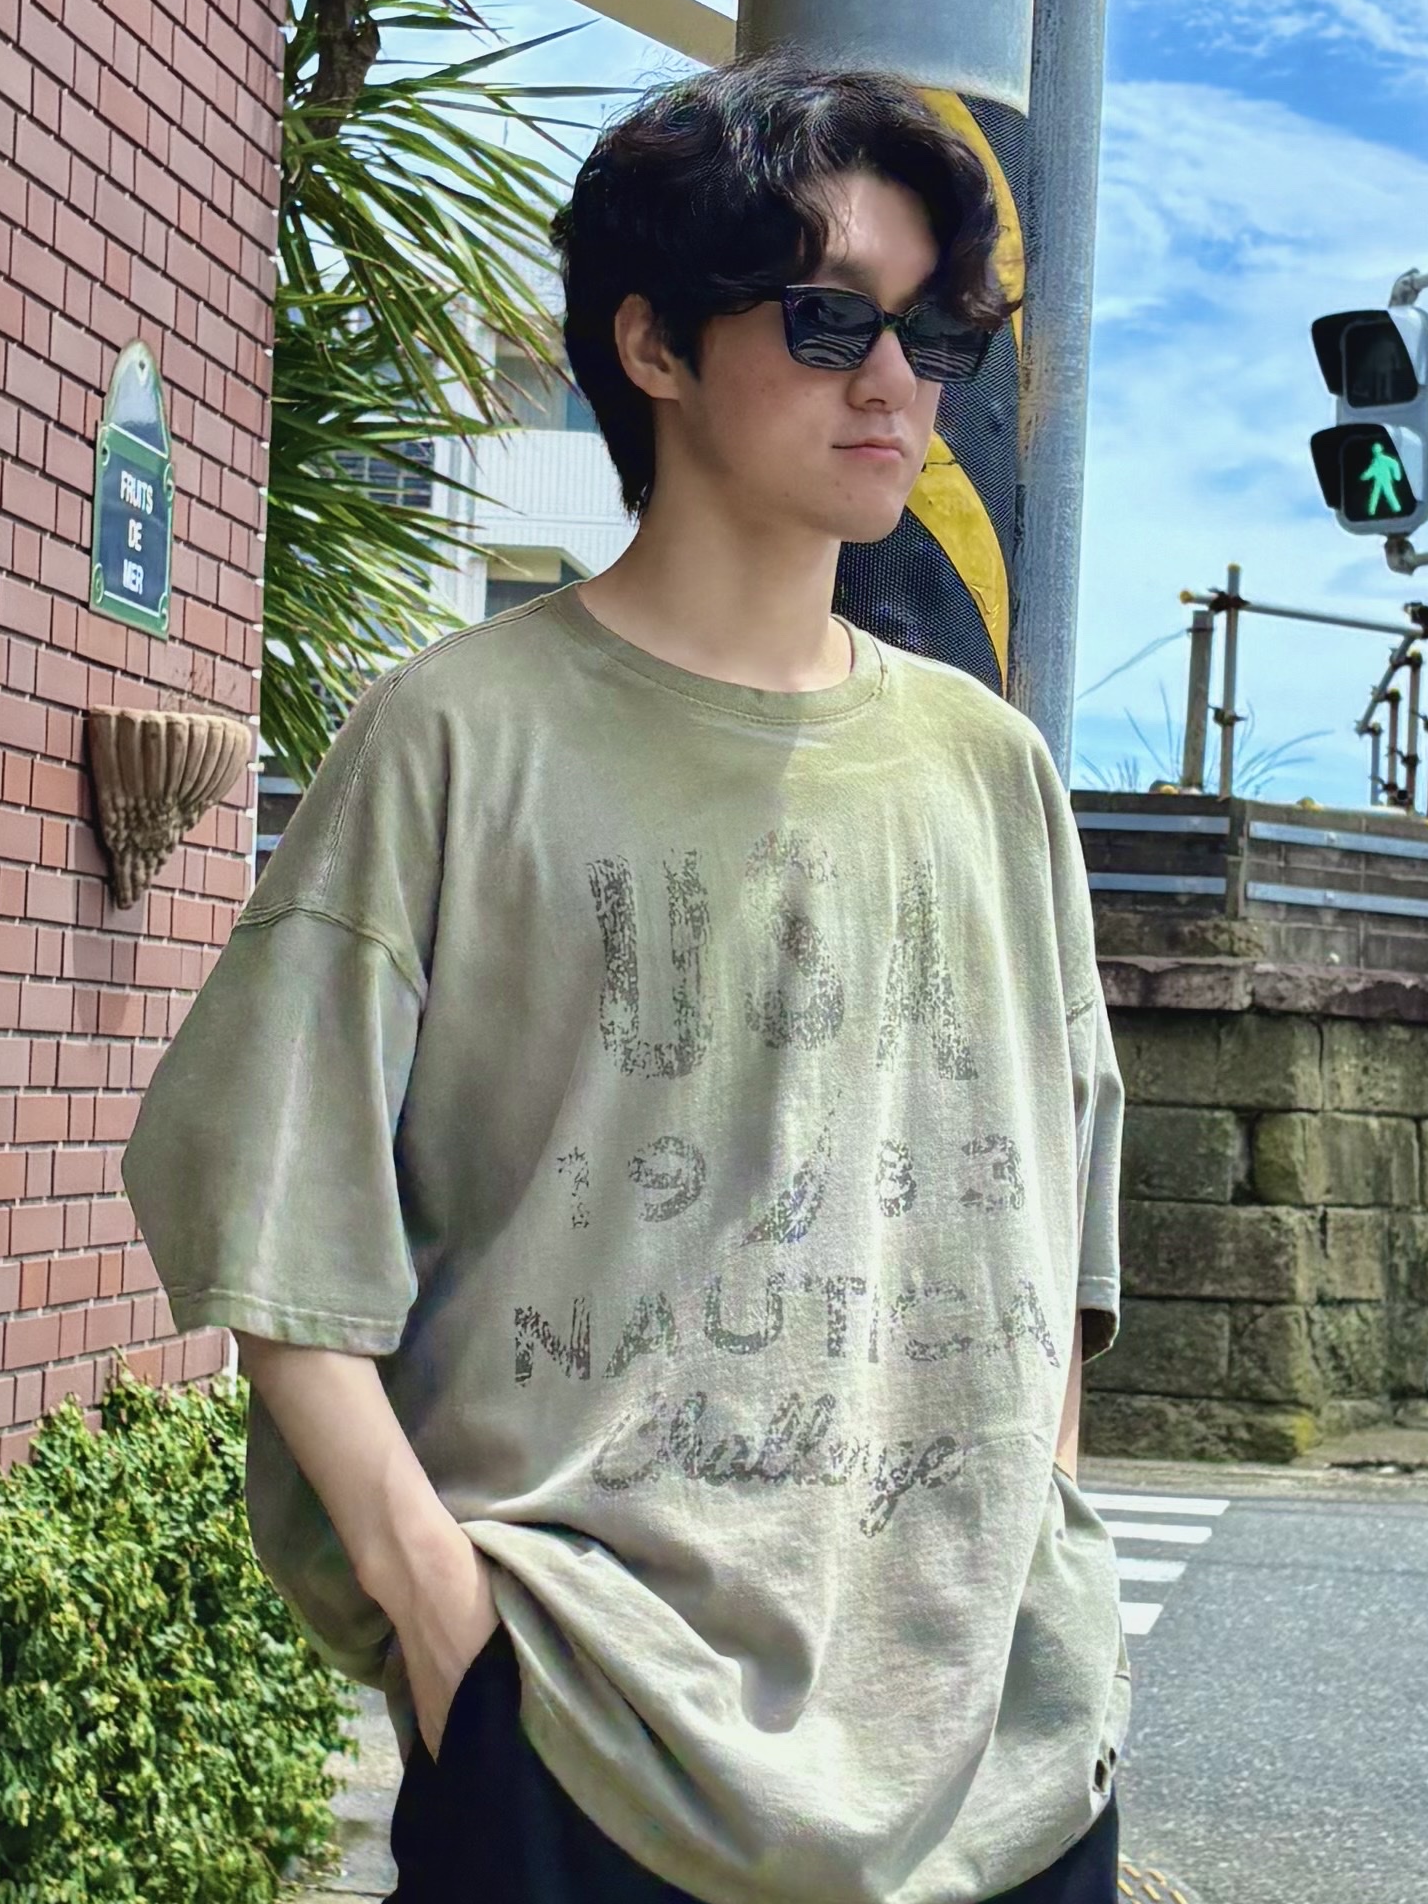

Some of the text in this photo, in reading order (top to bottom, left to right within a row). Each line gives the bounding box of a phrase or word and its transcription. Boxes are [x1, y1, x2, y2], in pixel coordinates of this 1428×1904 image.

[120, 470, 154, 515] FRUITS
[127, 519, 142, 552] DE
[122, 559, 144, 595] MER
[585, 829, 979, 1082] USA
